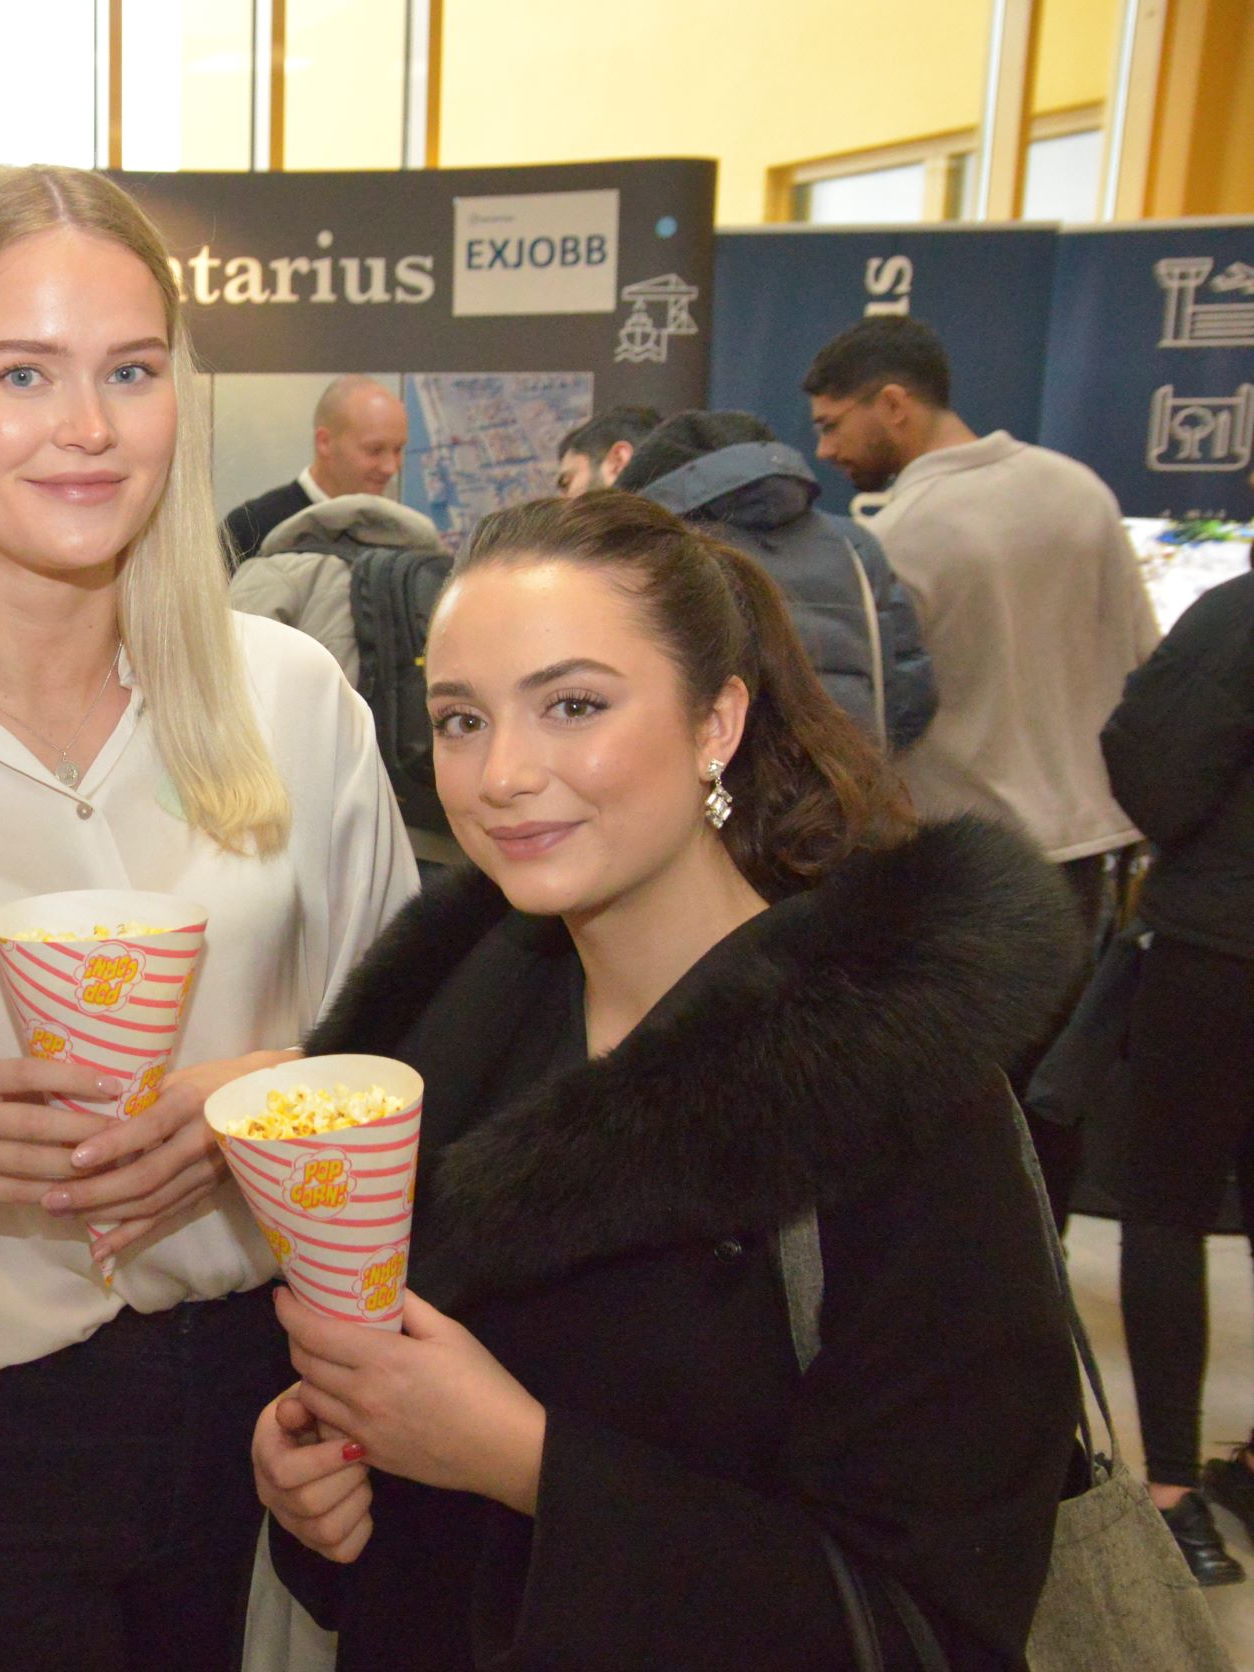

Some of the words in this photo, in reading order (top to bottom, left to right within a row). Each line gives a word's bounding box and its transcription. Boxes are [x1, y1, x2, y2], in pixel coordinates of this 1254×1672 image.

[466, 234, 607, 270] EXJOBB
[82, 980, 122, 1006] POP
[32, 1027, 66, 1053] POP
[303, 1159, 343, 1185] POP
[290, 1183, 347, 1209] CORN!
[365, 1279, 397, 1312] POP
